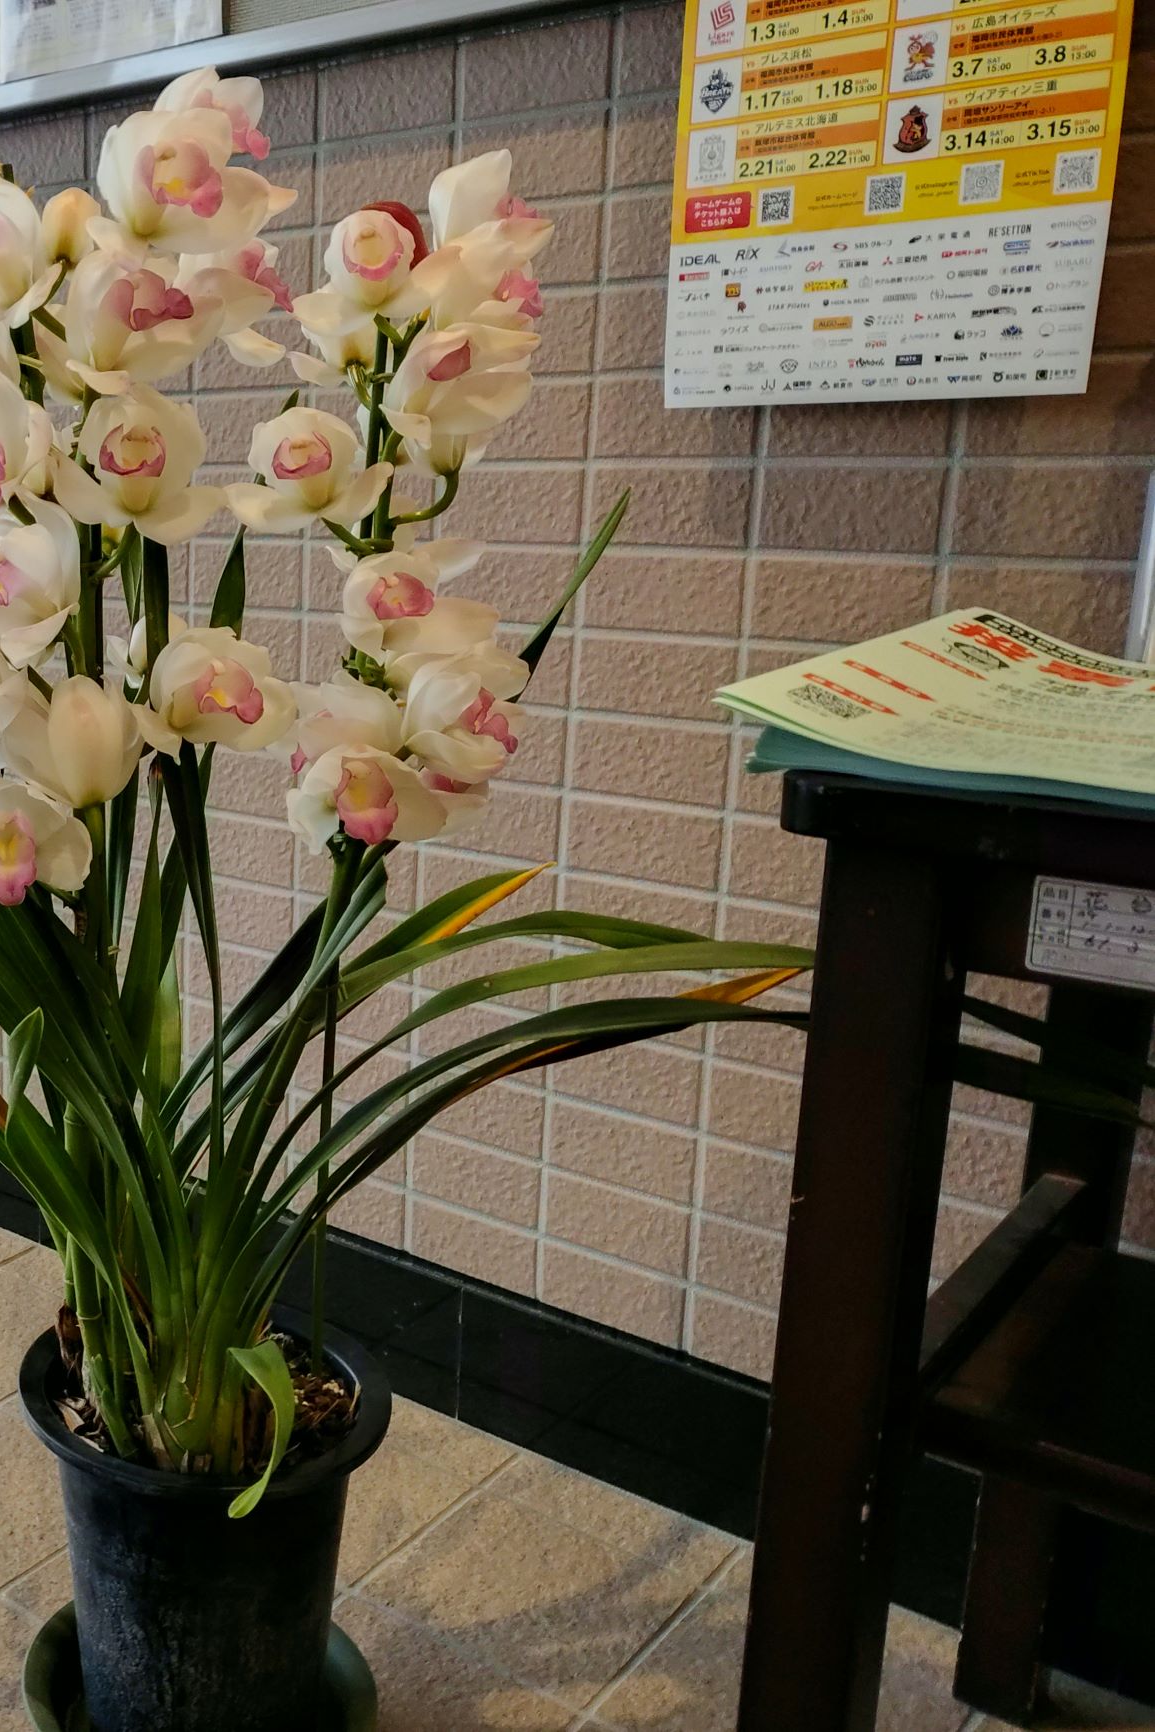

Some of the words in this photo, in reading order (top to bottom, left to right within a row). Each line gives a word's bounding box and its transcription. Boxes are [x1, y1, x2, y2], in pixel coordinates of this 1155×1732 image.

[822, 9, 848, 29] 1.4
[851, 13, 874, 24] 13:00
[972, 5, 1058, 29] 広島オイラーズ
[750, 23, 776, 43] 1.3
[1035, 46, 1066, 66] 3.8
[1071, 50, 1096, 60] 13:00
[952, 58, 983, 78] 3.7
[986, 62, 1011, 73] 15:00
[816, 79, 853, 99] 1.18
[855, 83, 877, 93] 13:00
[964, 80, 1058, 103] ヴィアティン三重
[745, 90, 781, 111] 1.17
[782, 95, 803, 105] 15:00
[755, 111, 838, 134] アルテミス北海道
[1027, 119, 1071, 141] 3.15
[1074, 124, 1100, 135] 13:00
[945, 130, 987, 151] 3.14
[990, 135, 1015, 145] 14:00
[809, 149, 847, 169] 2.22
[848, 153, 870, 163] 11:00
[739, 160, 774, 178] 2.21
[775, 164, 796, 173] 14:00
[694, 197, 743, 210] ホームゲームの
[701, 217, 733, 228] こちらから
[680, 253, 721, 267] IDEAL
